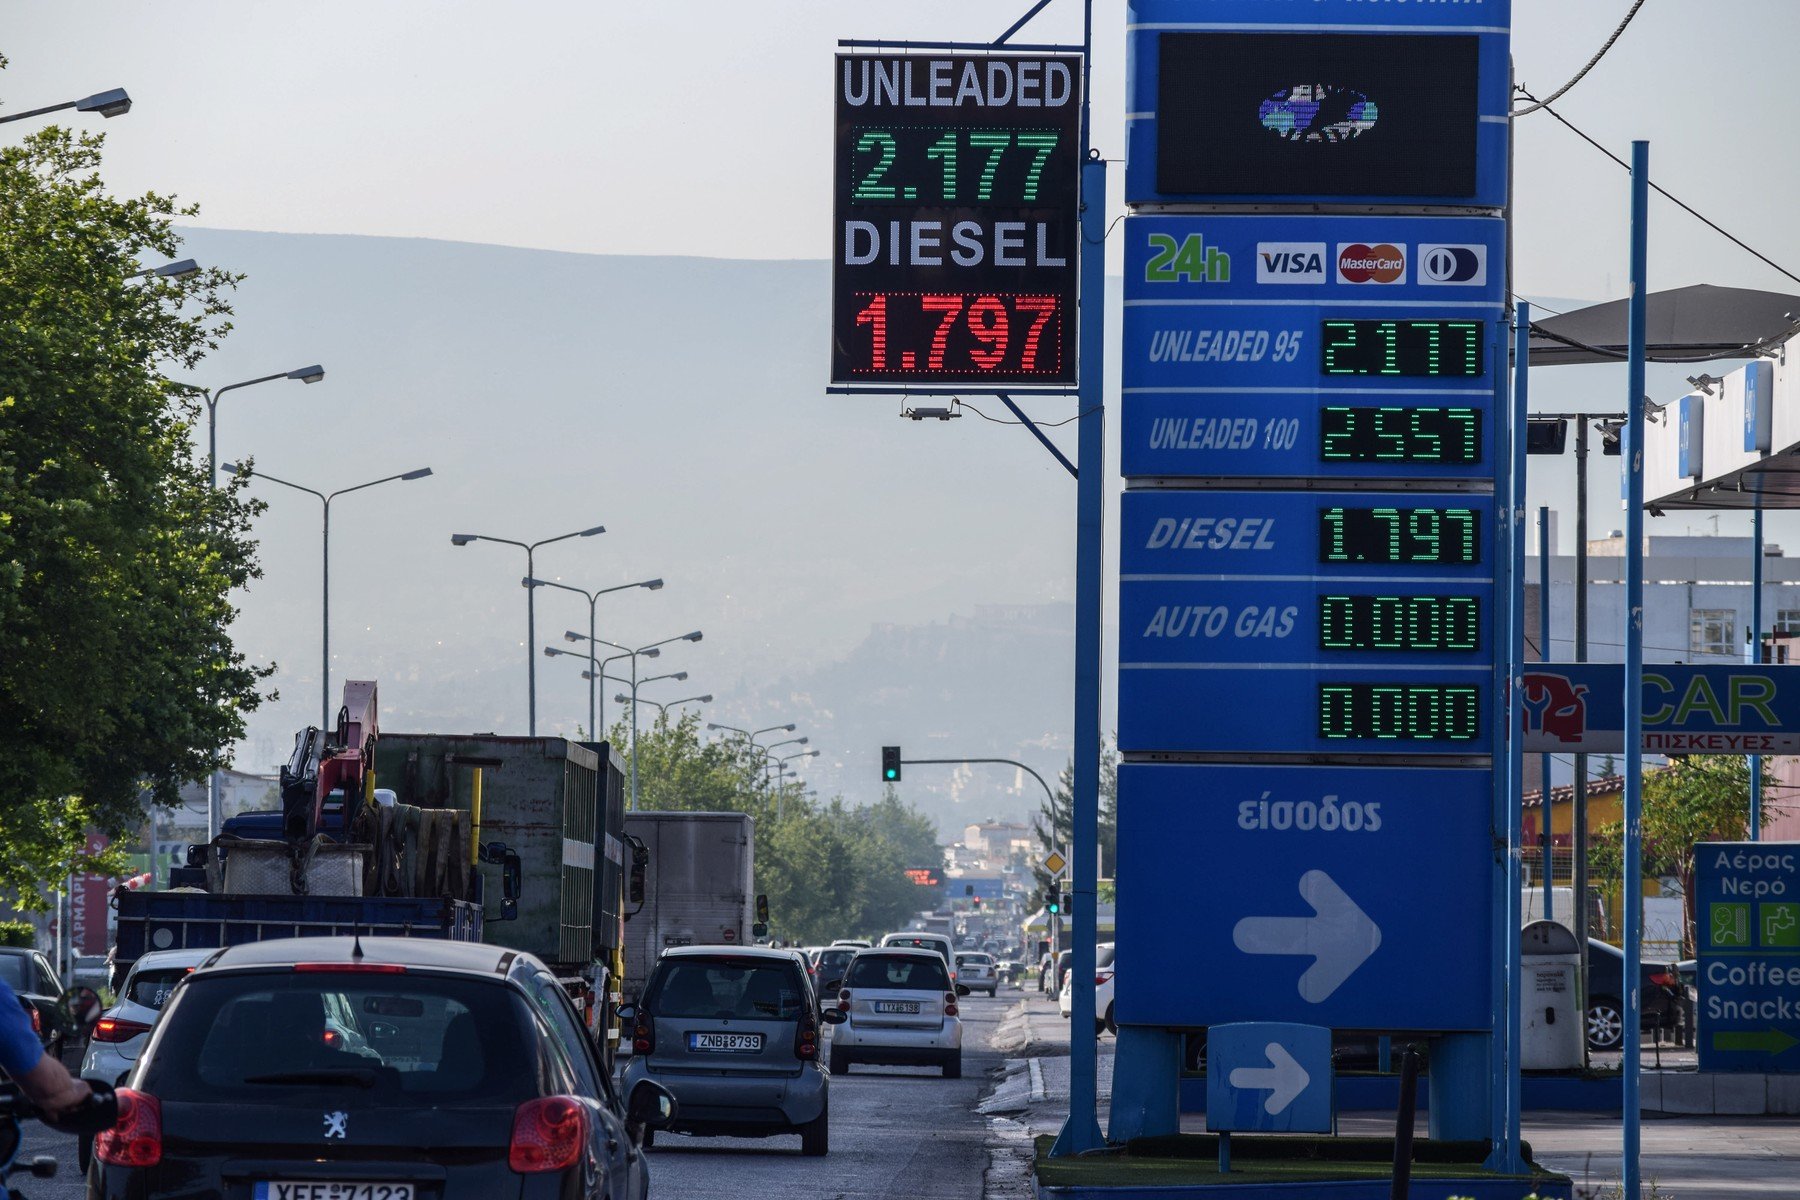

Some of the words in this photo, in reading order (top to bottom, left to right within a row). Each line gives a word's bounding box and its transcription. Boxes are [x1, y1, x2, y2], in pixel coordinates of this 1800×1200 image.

[844, 60, 1071, 107] UNLEADED
[855, 131, 1058, 200] 2.177
[845, 220, 1066, 267] DIESEL
[1145, 233, 1230, 283] 24h
[1259, 253, 1322, 273] VISA
[1340, 256, 1402, 271] MasterCard
[856, 295, 1056, 369] 1.797
[1150, 330, 1269, 362] UNLEADED
[1272, 330, 1303, 363] 95
[1326, 323, 1476, 374] 2.177
[1150, 418, 1260, 450] UNLEADED
[1262, 418, 1299, 450] 100
[1325, 407, 1475, 458] 2.557
[1145, 518, 1276, 550] DIESEL
[1324, 508, 1473, 561] 1.797
[1143, 606, 1229, 638] AUTO
[1234, 606, 1298, 638] GAS
[1323, 596, 1476, 648] 0.000
[1322, 687, 1476, 739] 0.000
[1624, 673, 1782, 727] CAR
[1237, 791, 1383, 832] είσοδος
[1714, 850, 1795, 873] Αέρας
[1722, 876, 1786, 899] Νερό
[1707, 961, 1800, 986] Coffee
